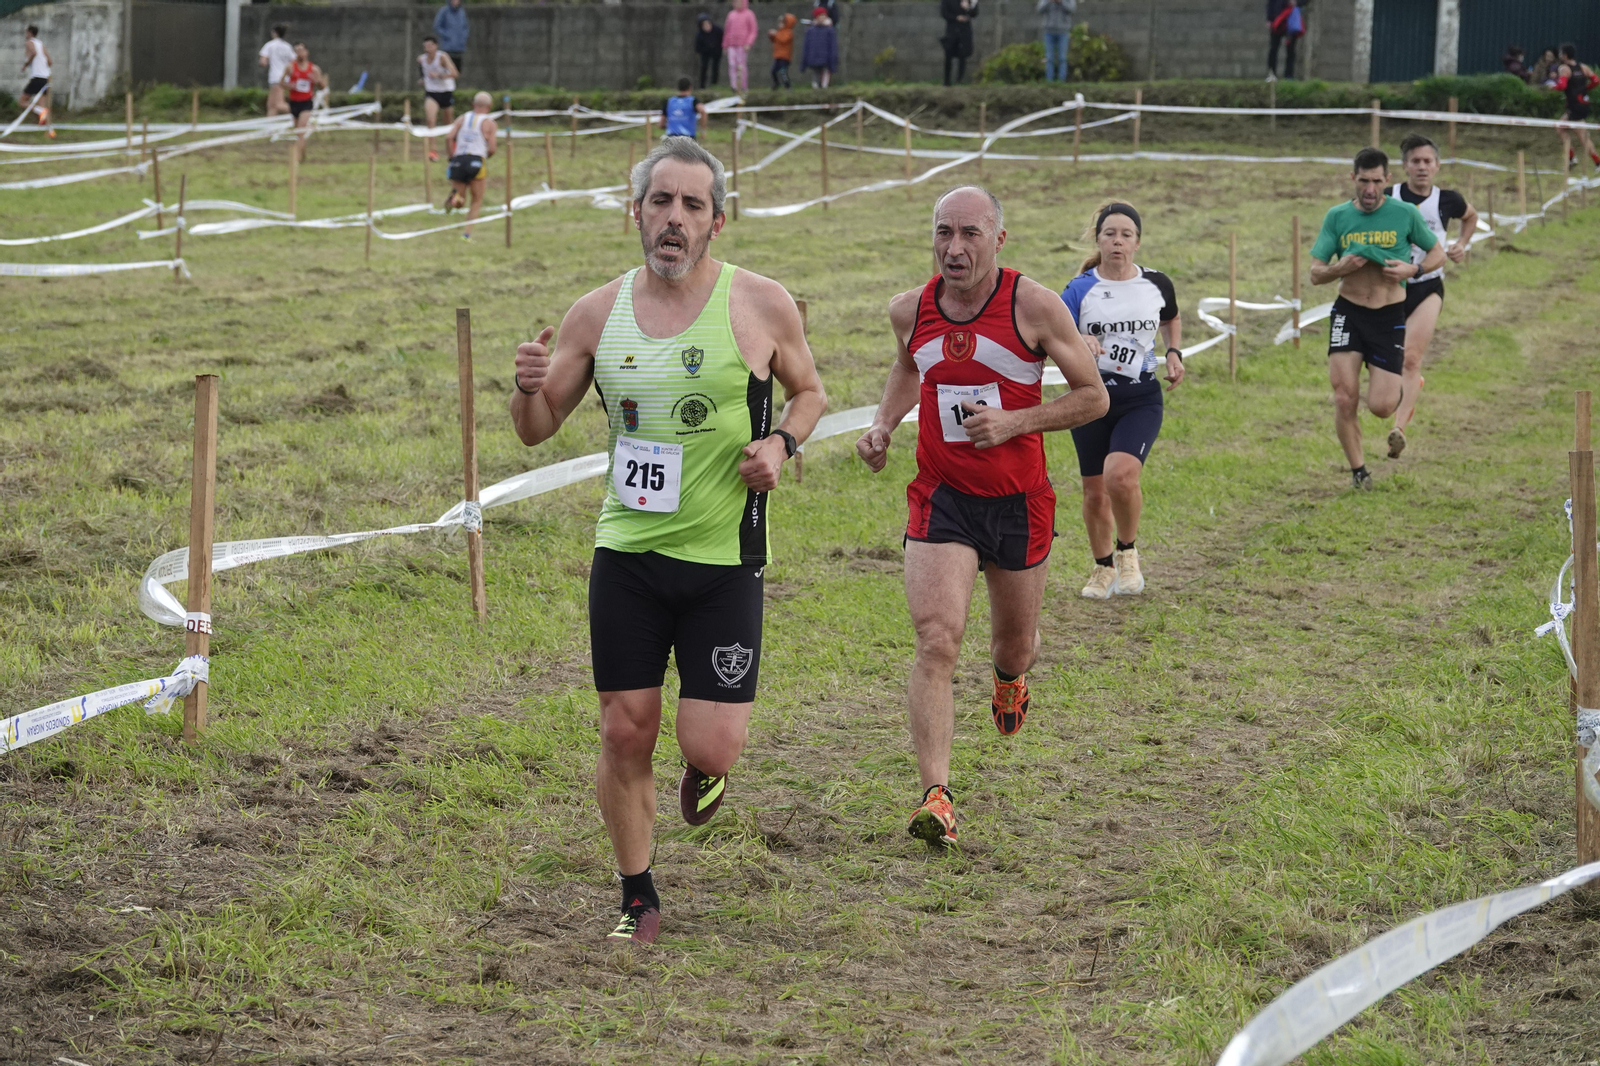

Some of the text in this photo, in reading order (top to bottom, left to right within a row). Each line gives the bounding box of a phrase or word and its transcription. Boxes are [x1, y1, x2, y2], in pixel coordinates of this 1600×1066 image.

[1109, 344, 1137, 365] 387
[625, 459, 665, 491] 215
[26, 722, 45, 737] NIGRAN
[45, 715, 71, 732] SONDEOS
